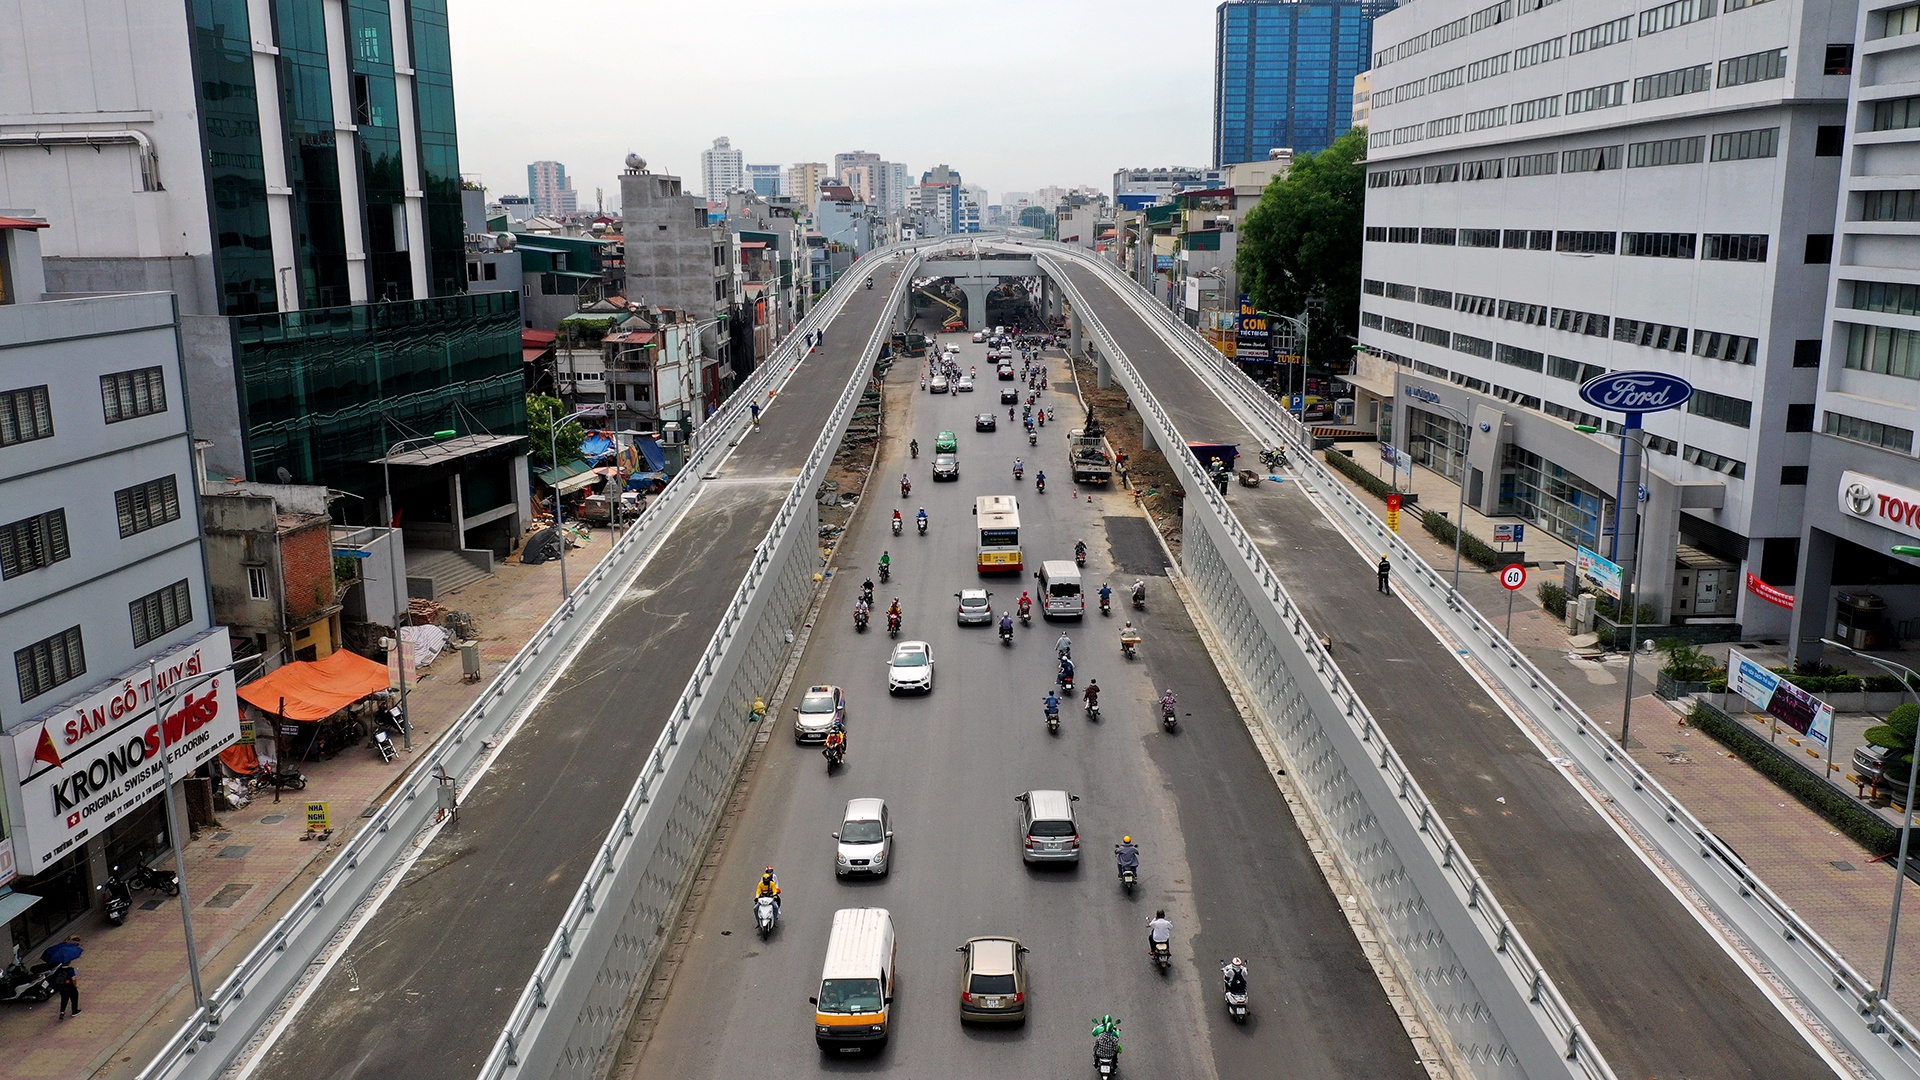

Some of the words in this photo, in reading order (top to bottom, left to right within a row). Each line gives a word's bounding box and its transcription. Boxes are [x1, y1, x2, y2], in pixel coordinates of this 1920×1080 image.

[1293, 397, 1300, 406] P
[1604, 379, 1670, 406] Ford
[1507, 572, 1519, 583] 60
[64, 704, 107, 745] SÀN
[110, 679, 138, 720] GỖ
[140, 662, 184, 703] THỤY
[186, 648, 203, 677] SĨ
[82, 786, 124, 818] ORIGINAL
[124, 767, 151, 792] SWISS
[151, 752, 174, 775] MAE
[174, 730, 210, 760] FLOORING
[307, 811, 325, 820] NGHỈ
